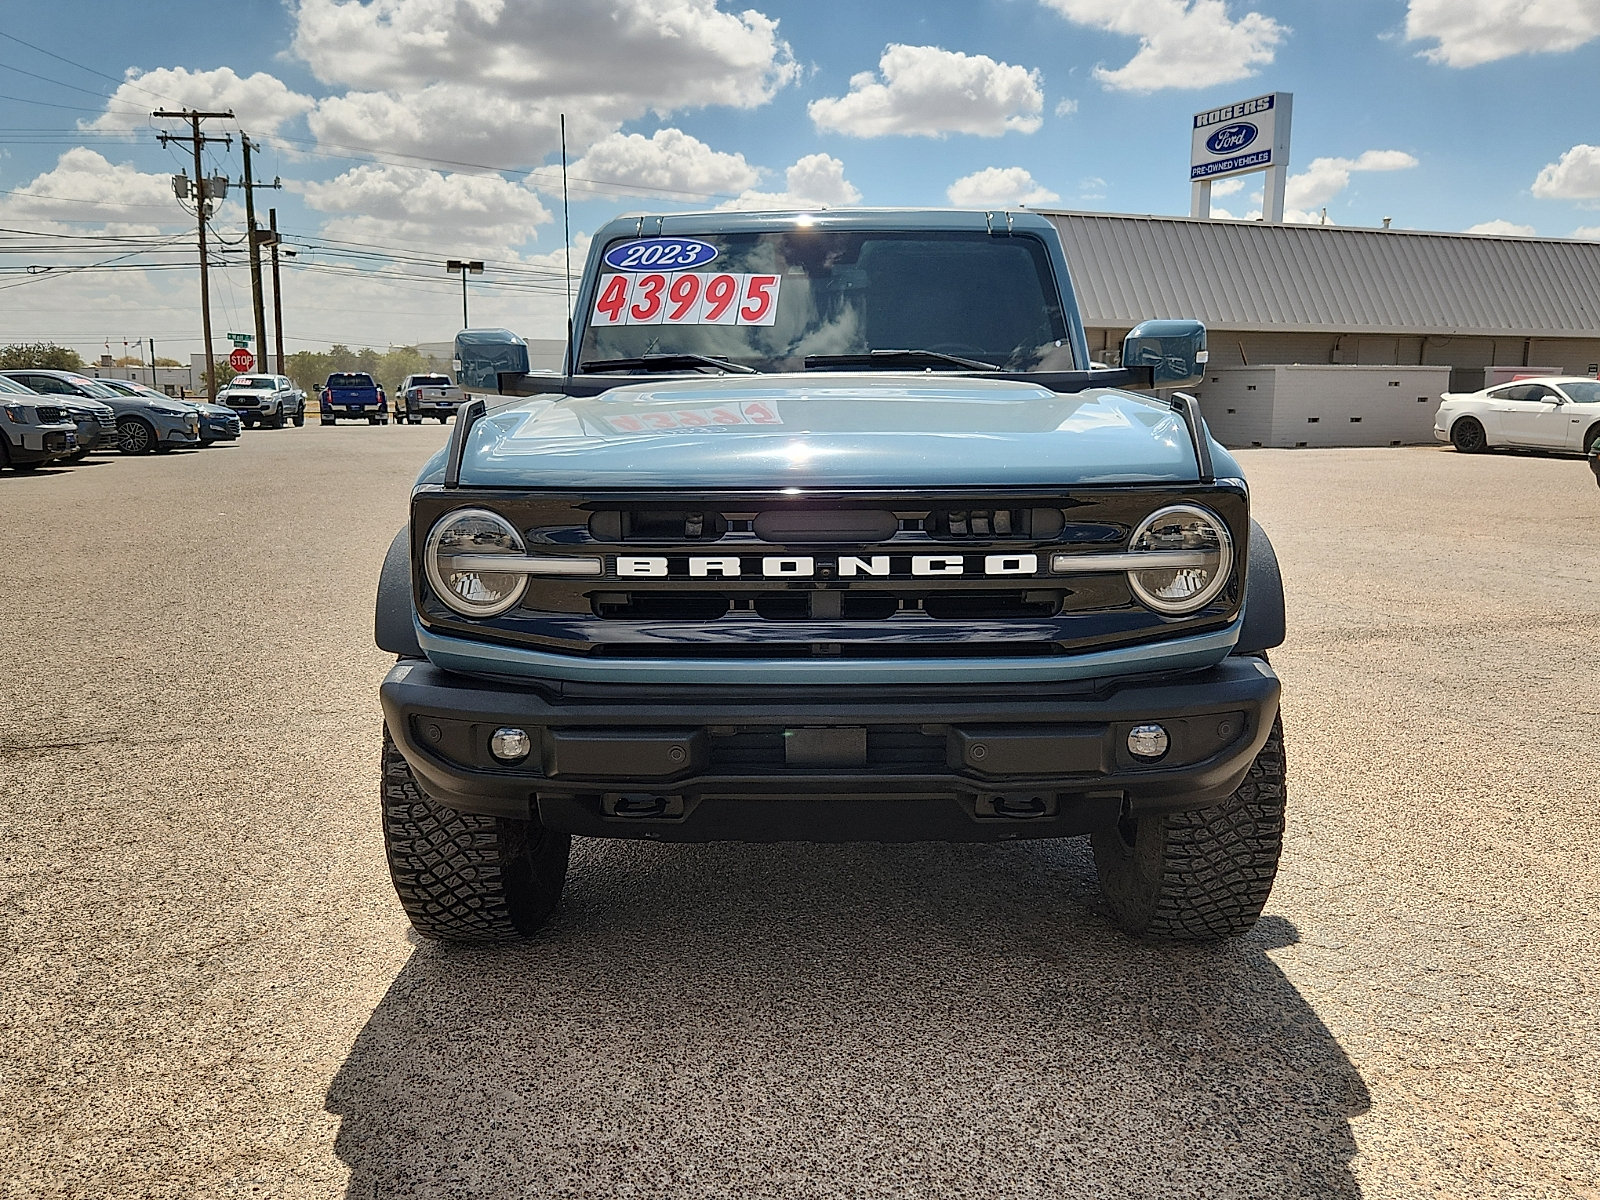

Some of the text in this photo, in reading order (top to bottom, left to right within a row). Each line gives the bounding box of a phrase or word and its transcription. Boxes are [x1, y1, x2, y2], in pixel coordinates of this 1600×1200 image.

[1197, 97, 1270, 127] ROGERS
[1215, 126, 1246, 150] Ford
[1192, 152, 1269, 176] PRE-OWNED VEHICLES
[620, 244, 703, 267] 2023
[597, 274, 778, 323] 43995
[231, 355, 252, 366] STOP
[616, 554, 1037, 577] BRONCO
